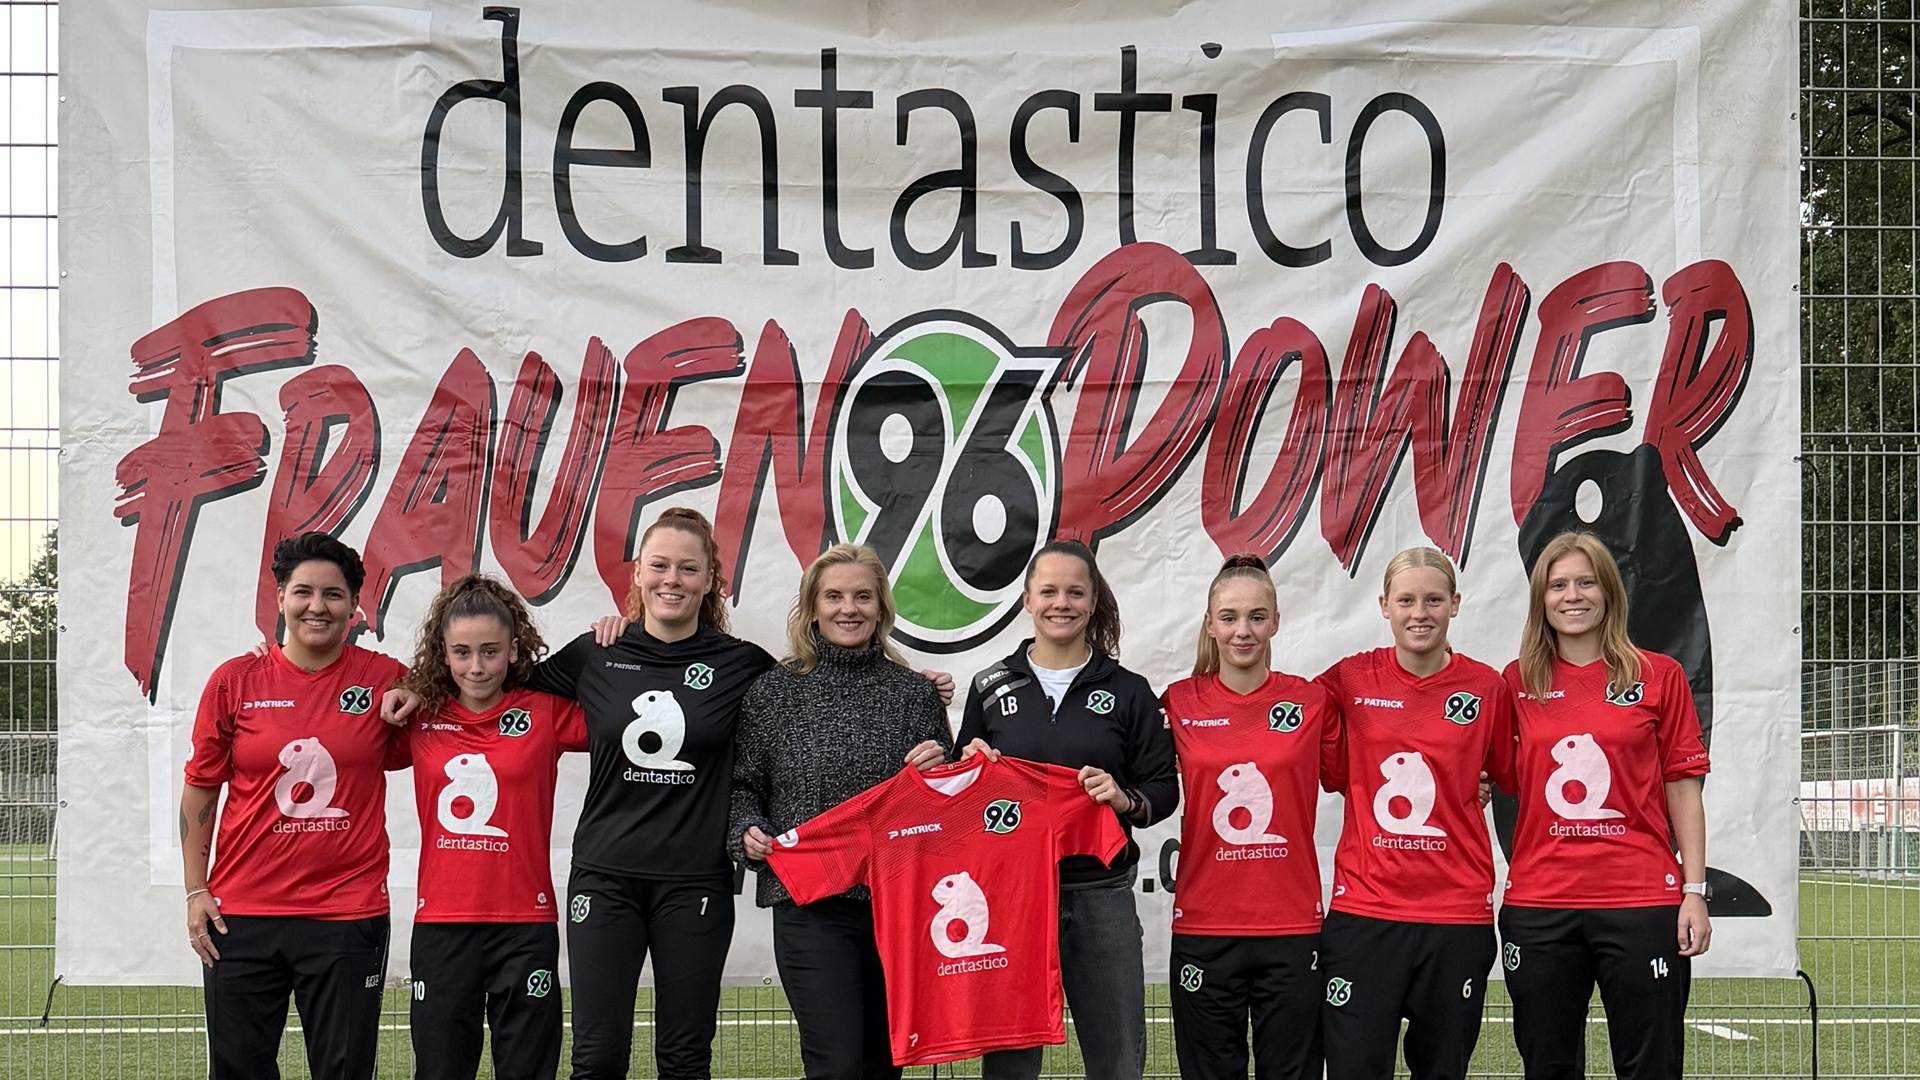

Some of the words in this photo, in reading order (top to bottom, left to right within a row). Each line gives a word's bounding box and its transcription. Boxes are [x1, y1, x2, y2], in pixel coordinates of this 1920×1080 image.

[421, 6, 1447, 271] dentastico
[613, 662, 642, 671] PATRICK
[684, 664, 714, 688] 96
[254, 699, 295, 709] PATRICK
[340, 688, 373, 713] 96
[1000, 696, 1018, 716] LB
[1087, 691, 1115, 711] 96
[1363, 698, 1405, 709] PATRICK
[1445, 693, 1483, 723] 96
[499, 710, 530, 736] 96
[1191, 717, 1231, 727] PATRICK
[1269, 702, 1303, 731] 96
[623, 767, 695, 784] dentastico
[272, 818, 351, 834] dentastico
[984, 800, 1021, 832] 96
[900, 822, 943, 838] PATRICK
[1549, 821, 1626, 838] dentastico
[436, 835, 510, 853] dentastico
[1372, 833, 1447, 851] dentastico
[1215, 845, 1289, 861] dentastico
[700, 897, 709, 916] 1
[937, 956, 1008, 977] dentastico
[1650, 957, 1669, 979] 14
[413, 980, 425, 1001] 10
[1462, 978, 1472, 999] 6
